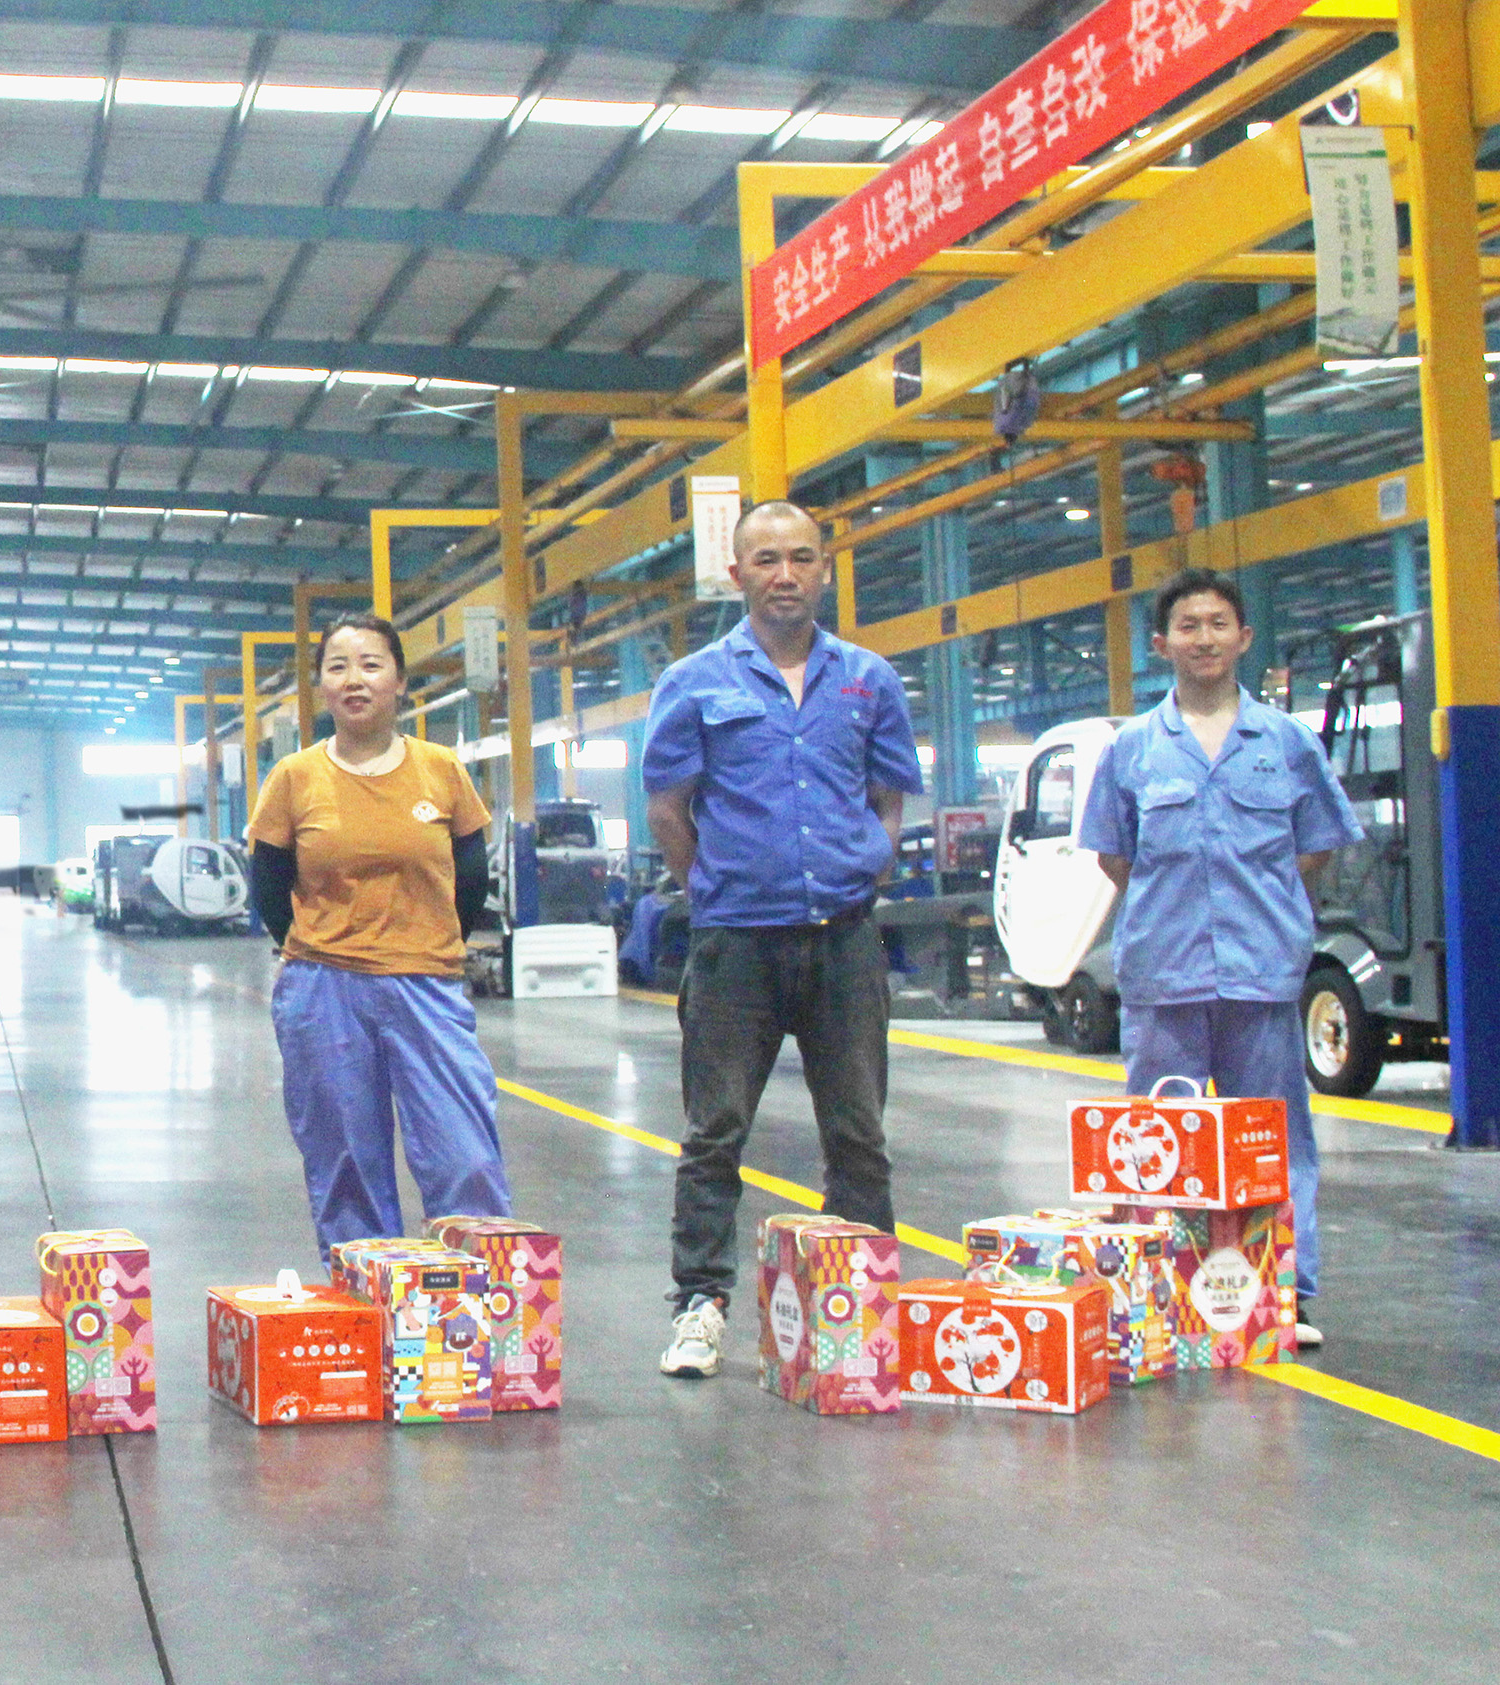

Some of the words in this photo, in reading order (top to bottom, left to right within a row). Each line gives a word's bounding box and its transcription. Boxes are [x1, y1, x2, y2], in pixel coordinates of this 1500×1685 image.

[773, 223, 850, 332] 安全生产
[862, 141, 964, 266] 从我做起
[978, 34, 1107, 189] 自查自改
